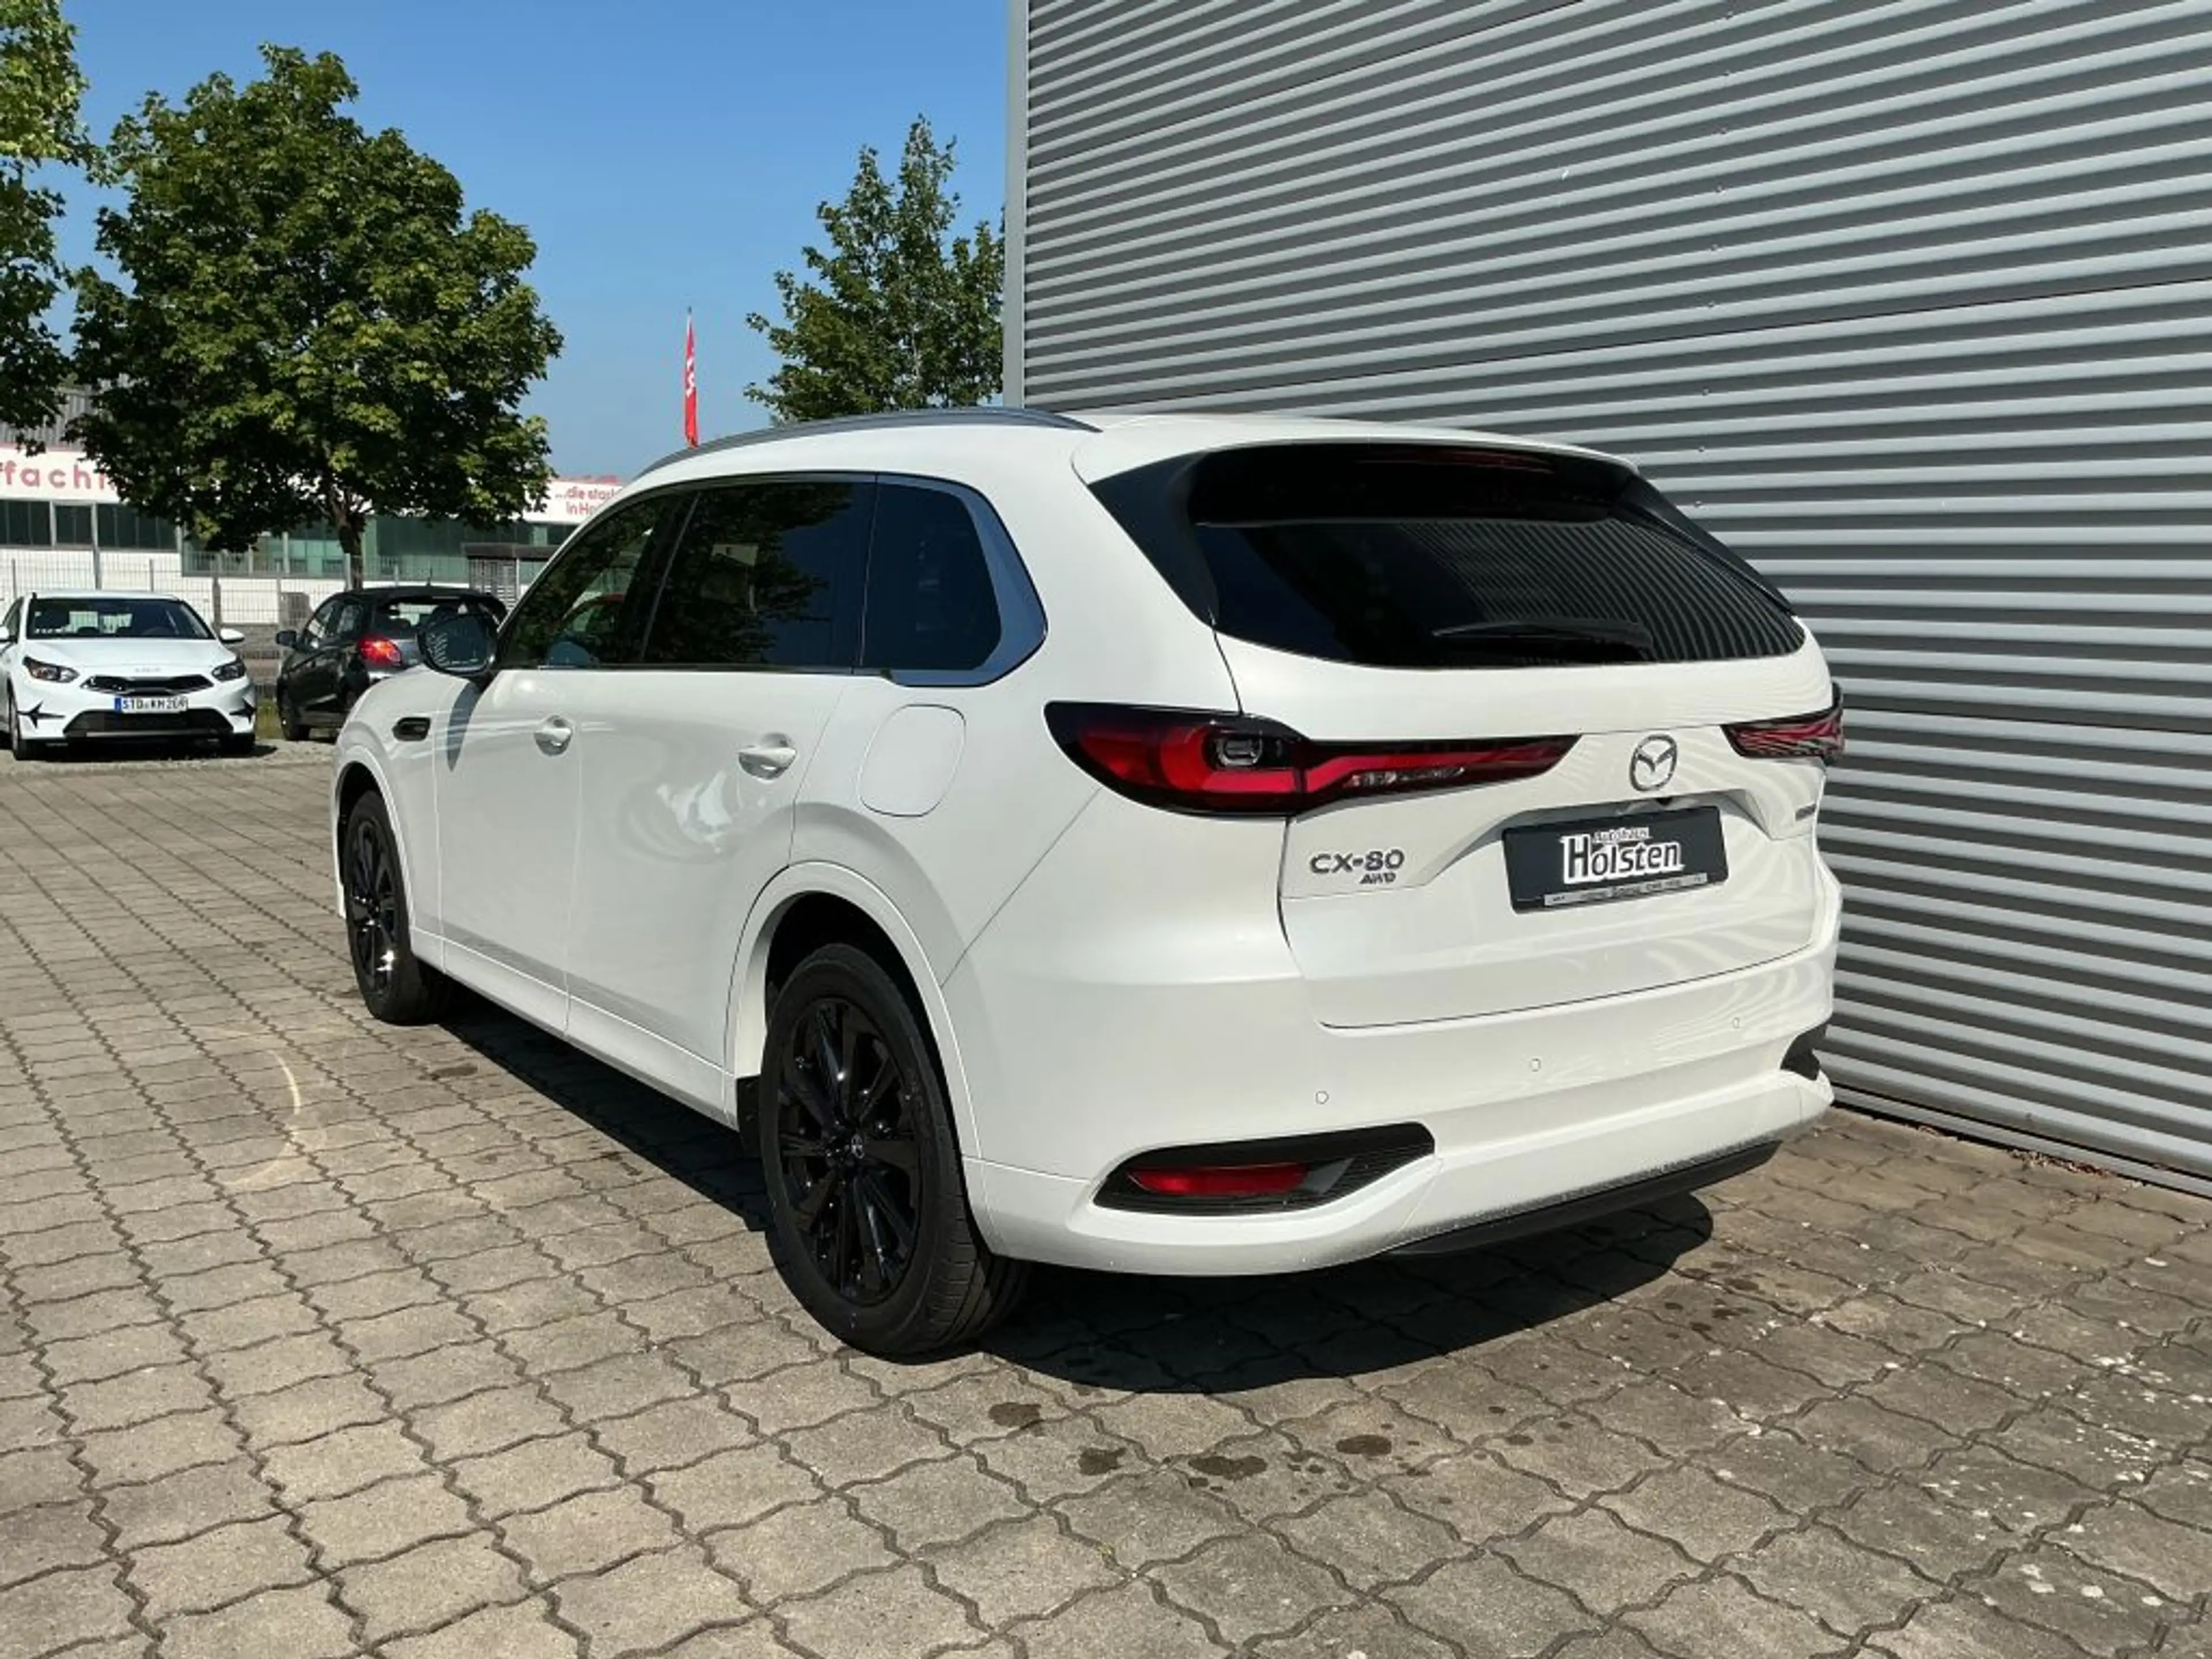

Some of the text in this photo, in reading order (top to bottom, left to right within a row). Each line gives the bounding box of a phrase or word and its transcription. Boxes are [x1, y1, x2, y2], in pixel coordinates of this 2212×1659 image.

[1309, 849, 1405, 874] CX-80
[1567, 834, 1679, 880] Holsten
[1359, 872, 1397, 885] AWD
